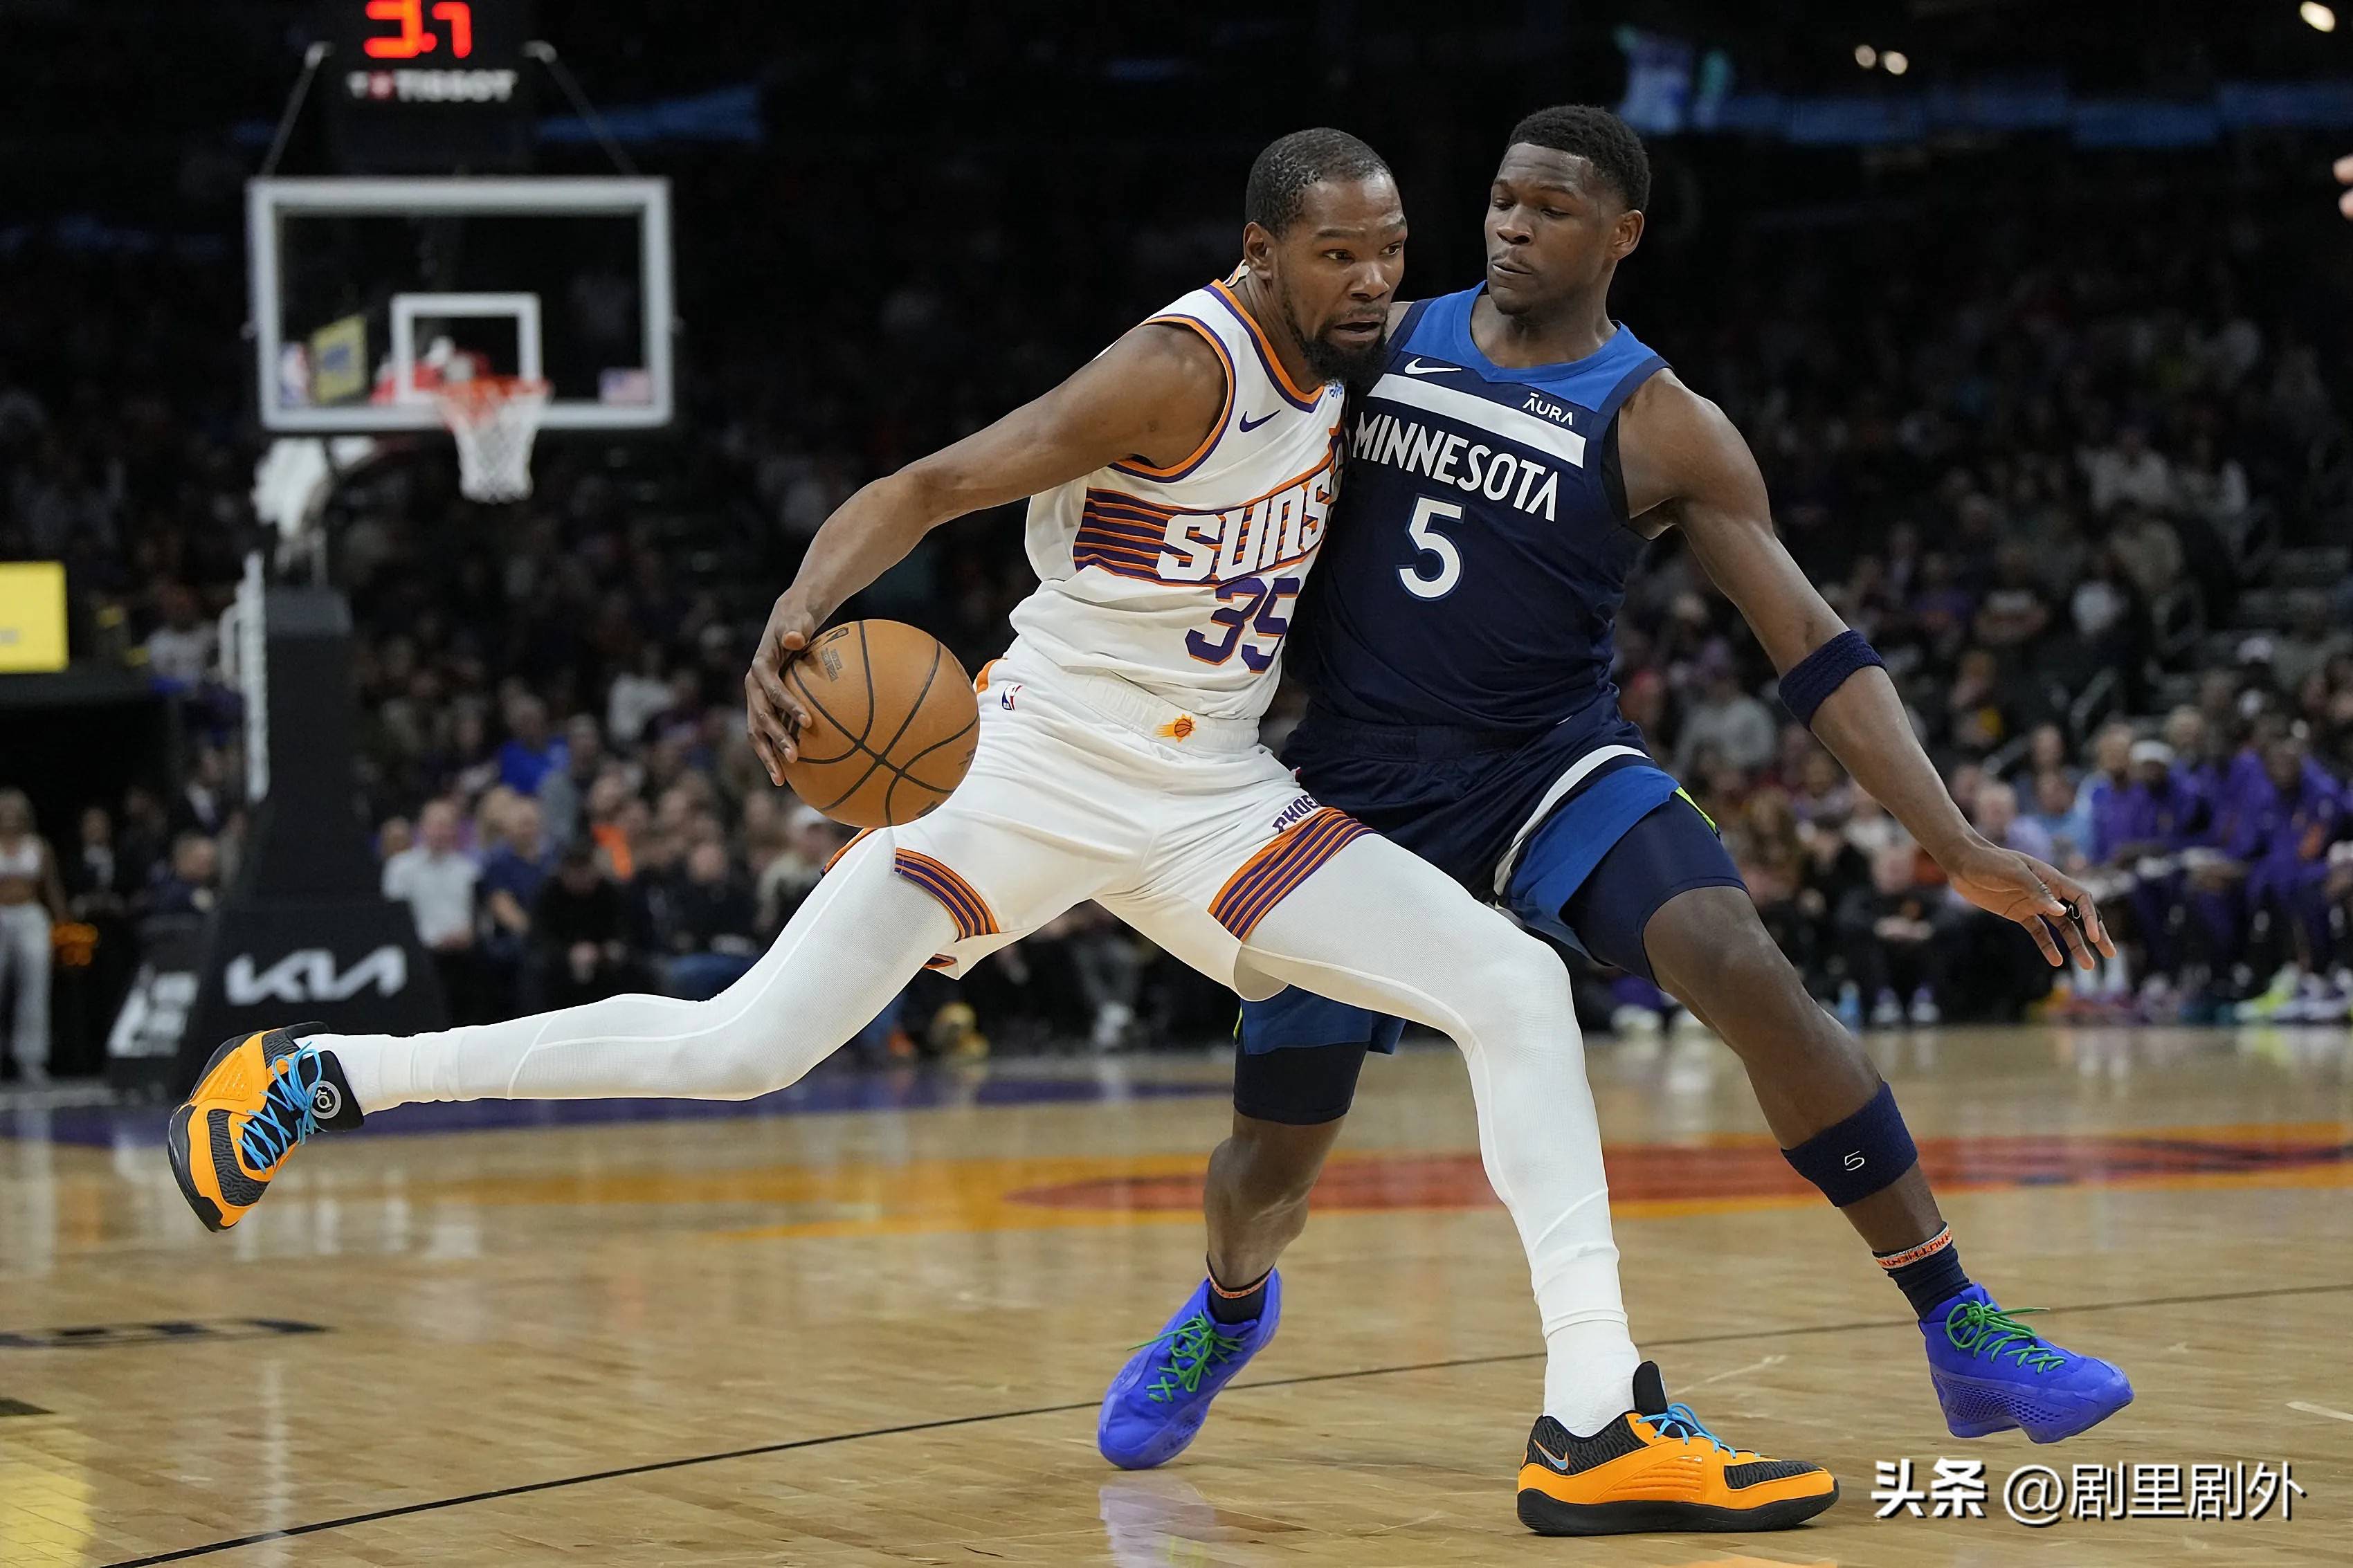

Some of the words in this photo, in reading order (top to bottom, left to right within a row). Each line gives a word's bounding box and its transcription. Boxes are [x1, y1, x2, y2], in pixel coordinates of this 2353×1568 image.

[1352, 411, 1559, 522] MINNESOTA
[1156, 468, 1331, 582] SUNS
[1397, 494, 1464, 600] 5
[1184, 577, 1300, 674] 35
[225, 944, 408, 1007] KIA
[1844, 1149, 1866, 1172] 5
